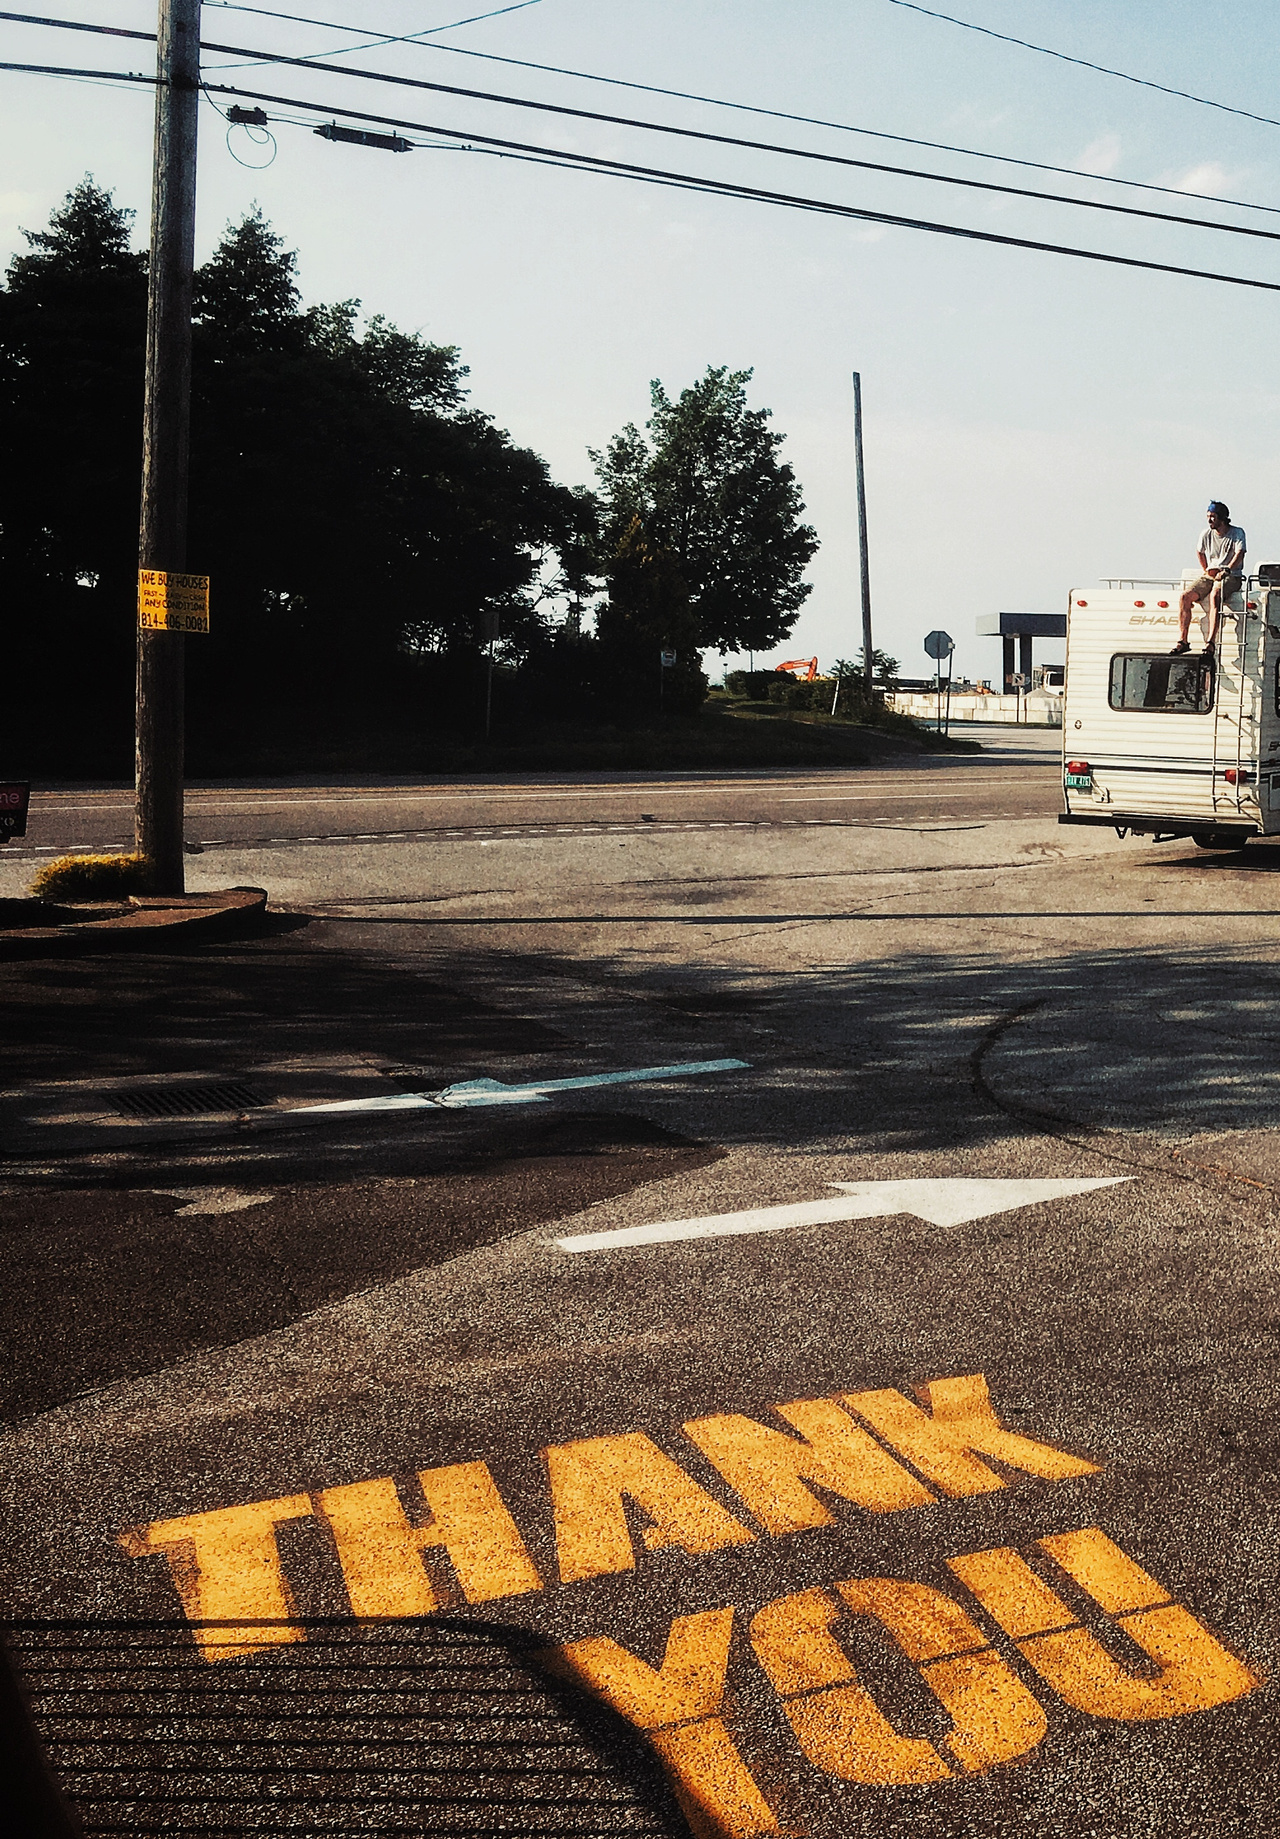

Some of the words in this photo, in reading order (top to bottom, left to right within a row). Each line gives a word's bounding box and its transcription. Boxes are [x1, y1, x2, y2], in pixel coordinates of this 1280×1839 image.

[142, 572, 156, 585] WE
[158, 573, 174, 588] BUY
[176, 576, 209, 590] HOUSES
[145, 598, 161, 608] ANY
[162, 600, 205, 611] CONDITION
[115, 1372, 1104, 1663] THANK
[540, 1527, 1262, 1839] YOU
